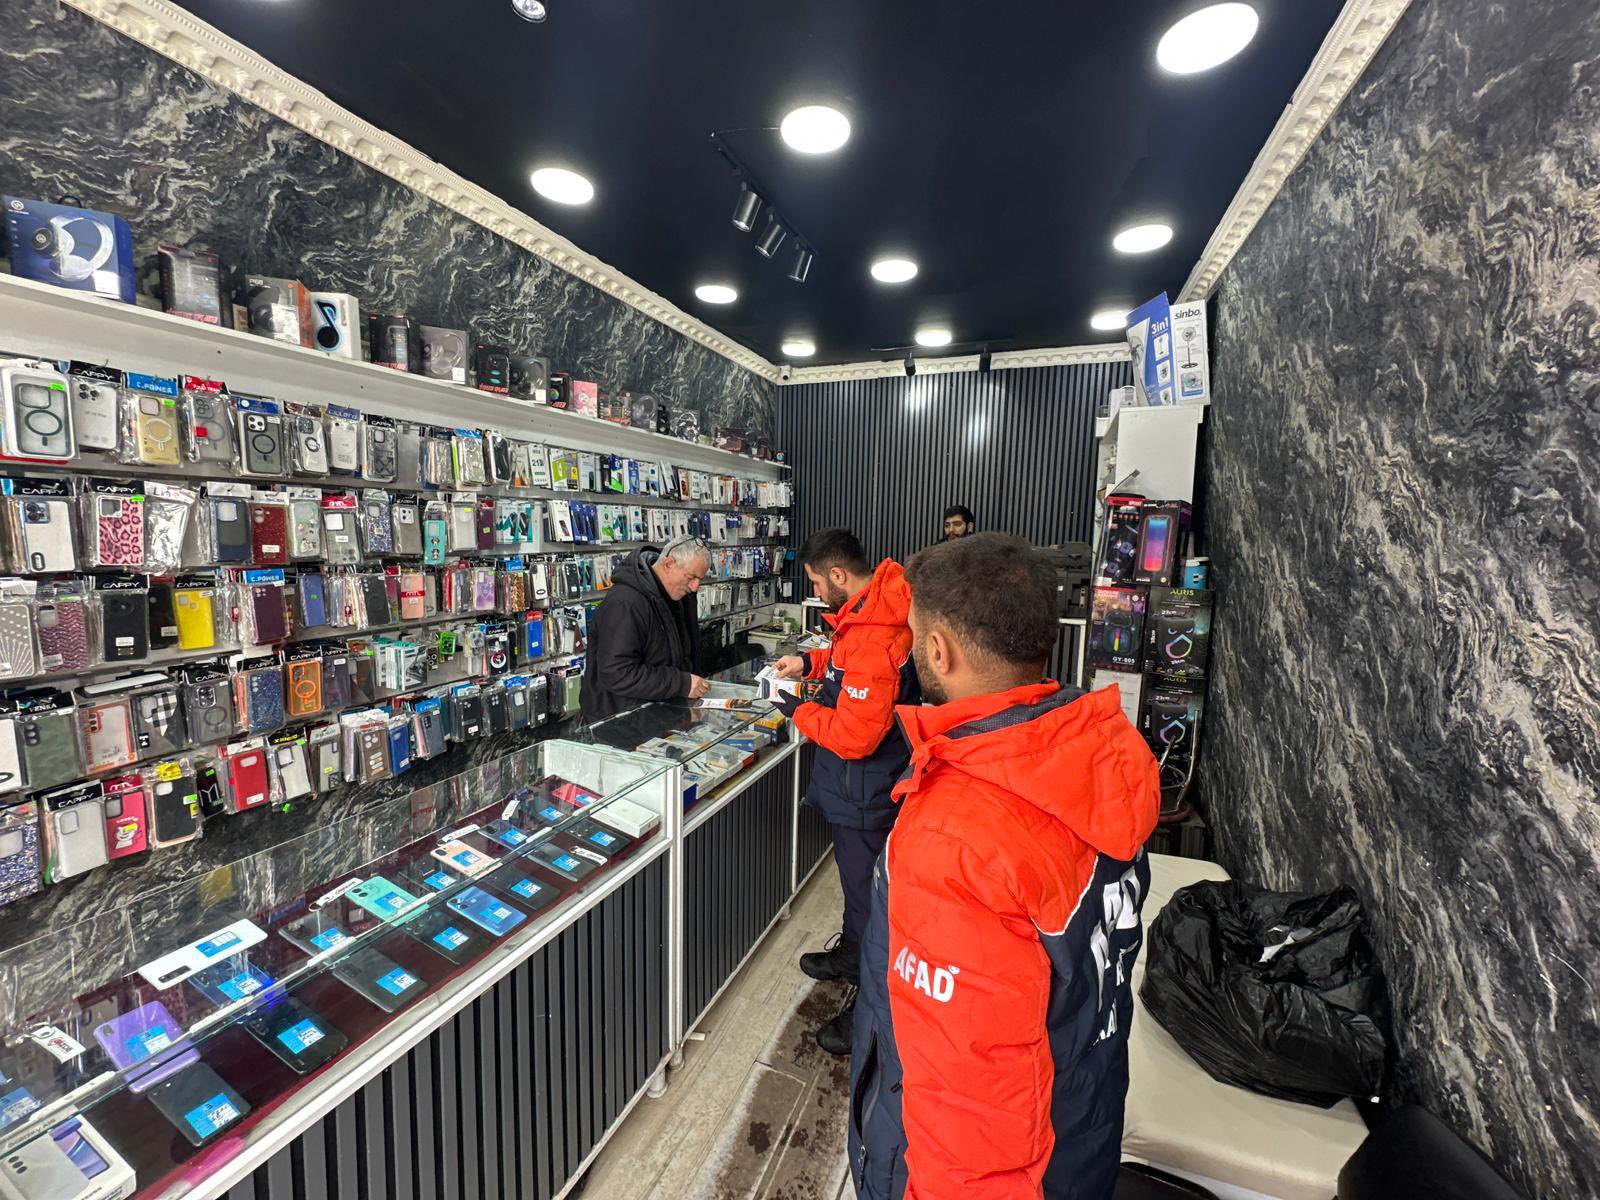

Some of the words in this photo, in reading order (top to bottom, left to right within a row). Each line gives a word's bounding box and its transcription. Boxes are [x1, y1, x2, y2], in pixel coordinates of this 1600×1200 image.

[1151, 316, 1169, 335] 3in1
[22, 487, 65, 495] CAPPY
[96, 485, 136, 493] CAPPY
[102, 581, 140, 589] CAPPY
[176, 581, 209, 589] CAPPY
[1169, 588, 1195, 596] AURIS
[249, 660, 276, 669] CAPPY
[58, 793, 94, 808] CAPPY
[893, 946, 956, 1003] AFAD
